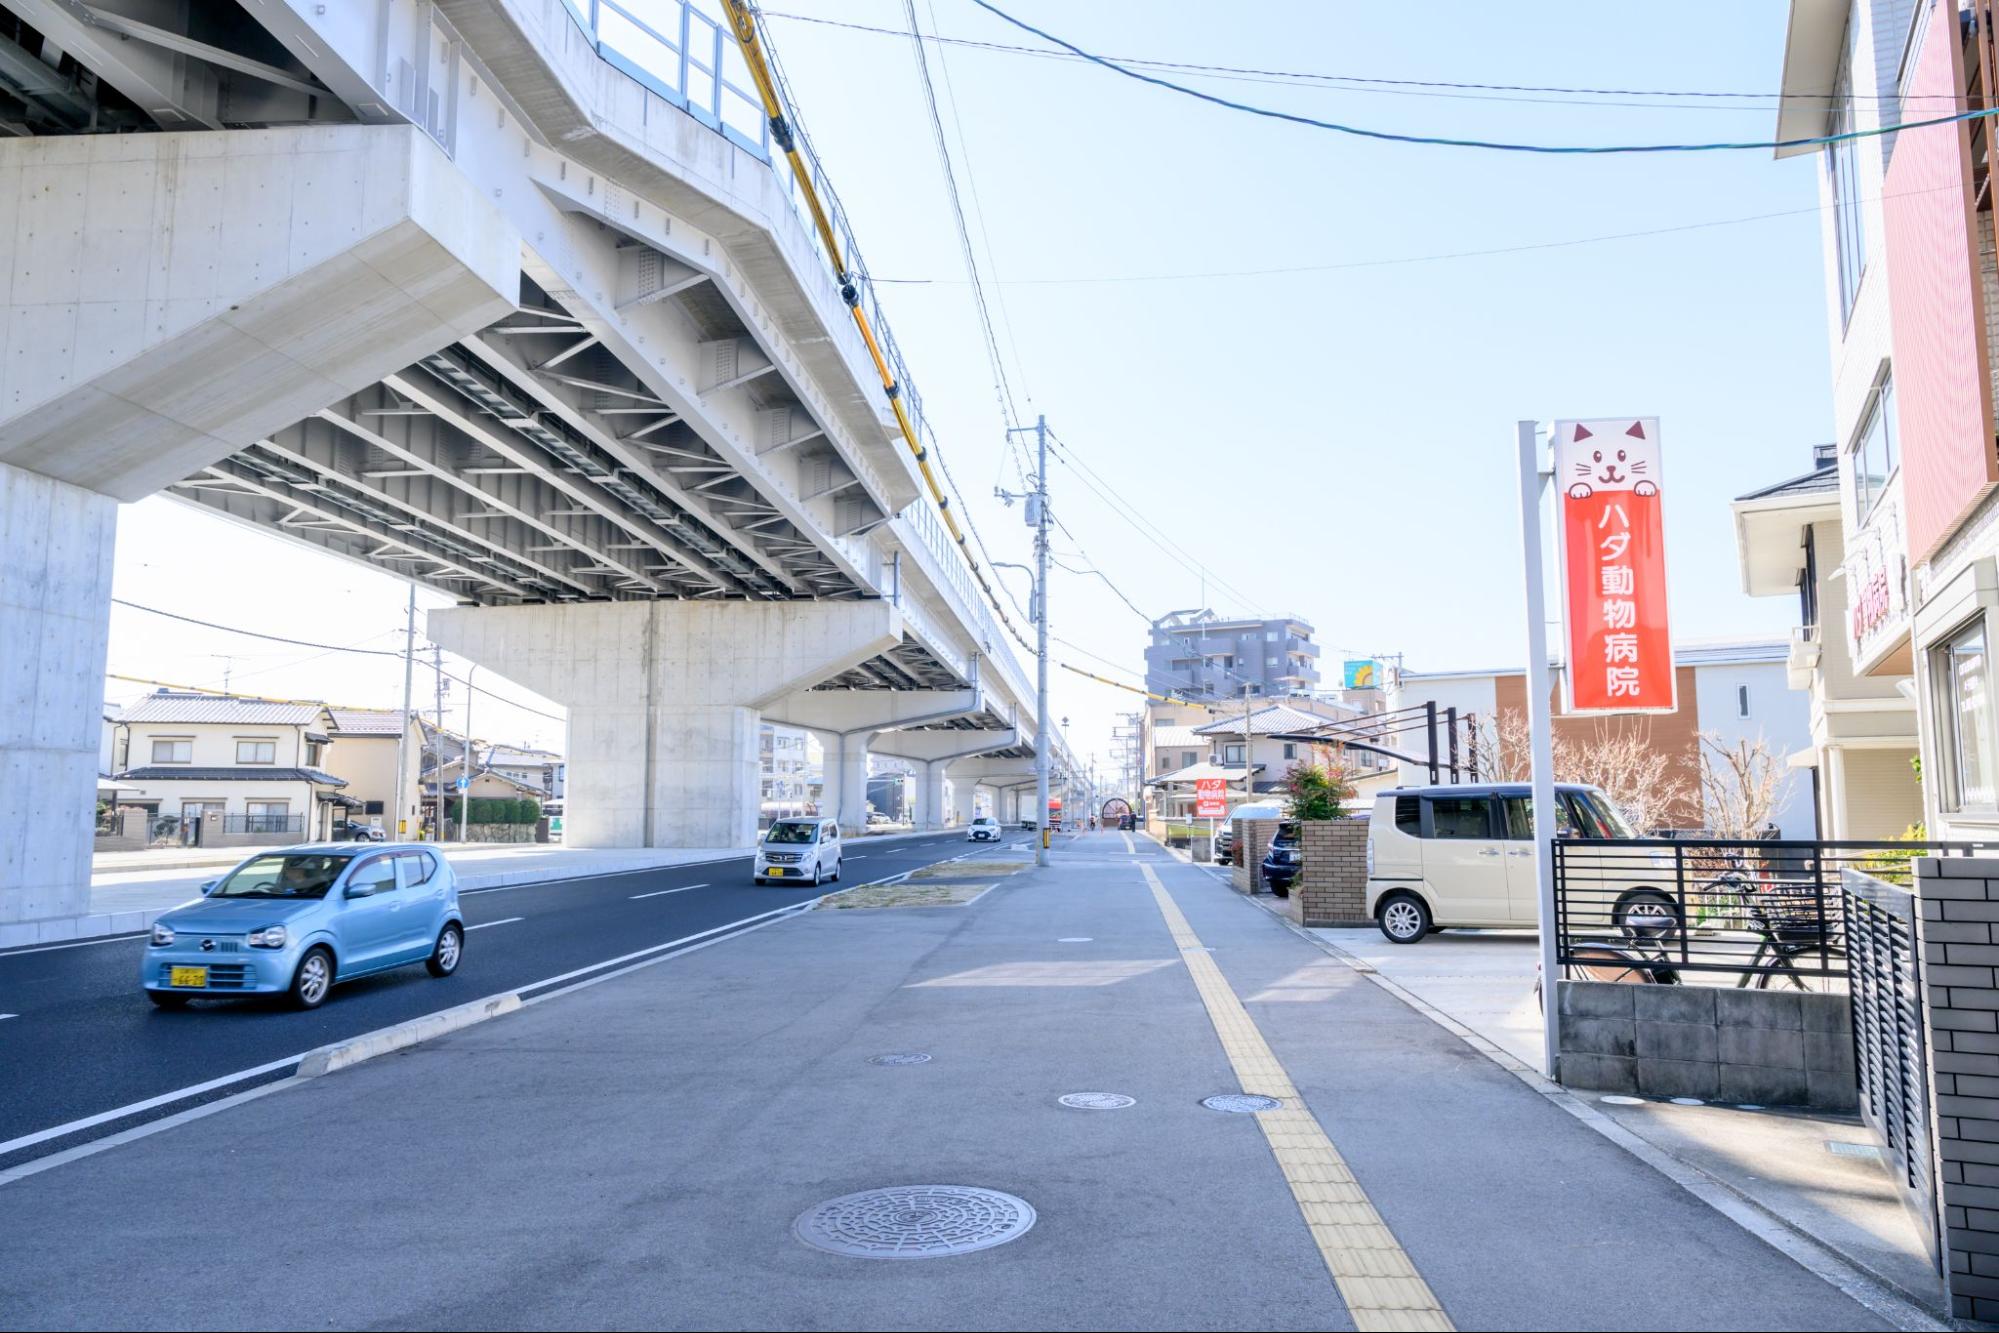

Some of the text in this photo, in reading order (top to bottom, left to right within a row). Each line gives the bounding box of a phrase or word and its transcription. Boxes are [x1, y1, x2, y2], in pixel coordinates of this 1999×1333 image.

[1598, 503, 1640, 697] ハダ動物病院
